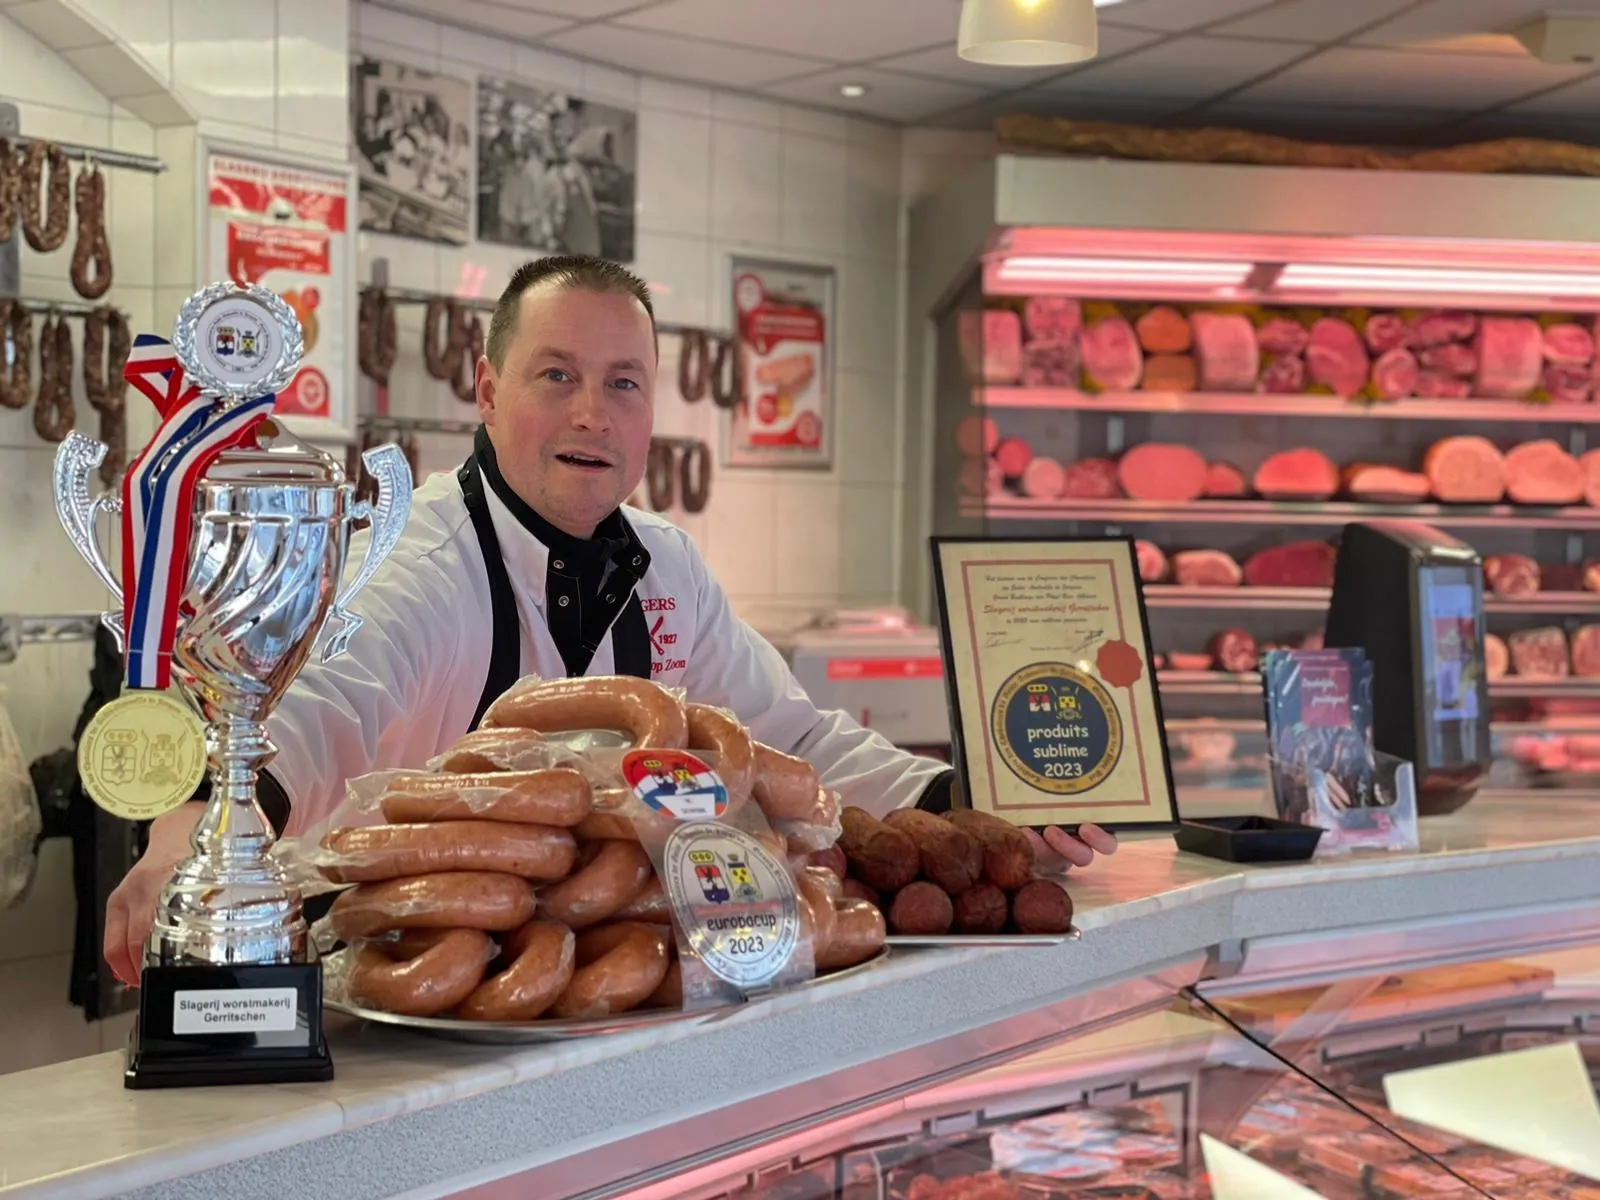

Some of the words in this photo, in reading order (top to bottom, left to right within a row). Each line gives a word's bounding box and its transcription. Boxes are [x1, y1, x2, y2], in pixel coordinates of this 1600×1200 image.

[658, 634, 677, 644] 1927
[1027, 723, 1089, 743] produits
[1033, 743, 1089, 759] sublime
[1044, 762, 1083, 777] 2023
[707, 914, 776, 931] europacup
[729, 936, 765, 954] 2023
[179, 999, 220, 1012] Slagerij
[223, 997, 291, 1009] worstmakerij
[203, 1011, 266, 1024] Gerritschen
